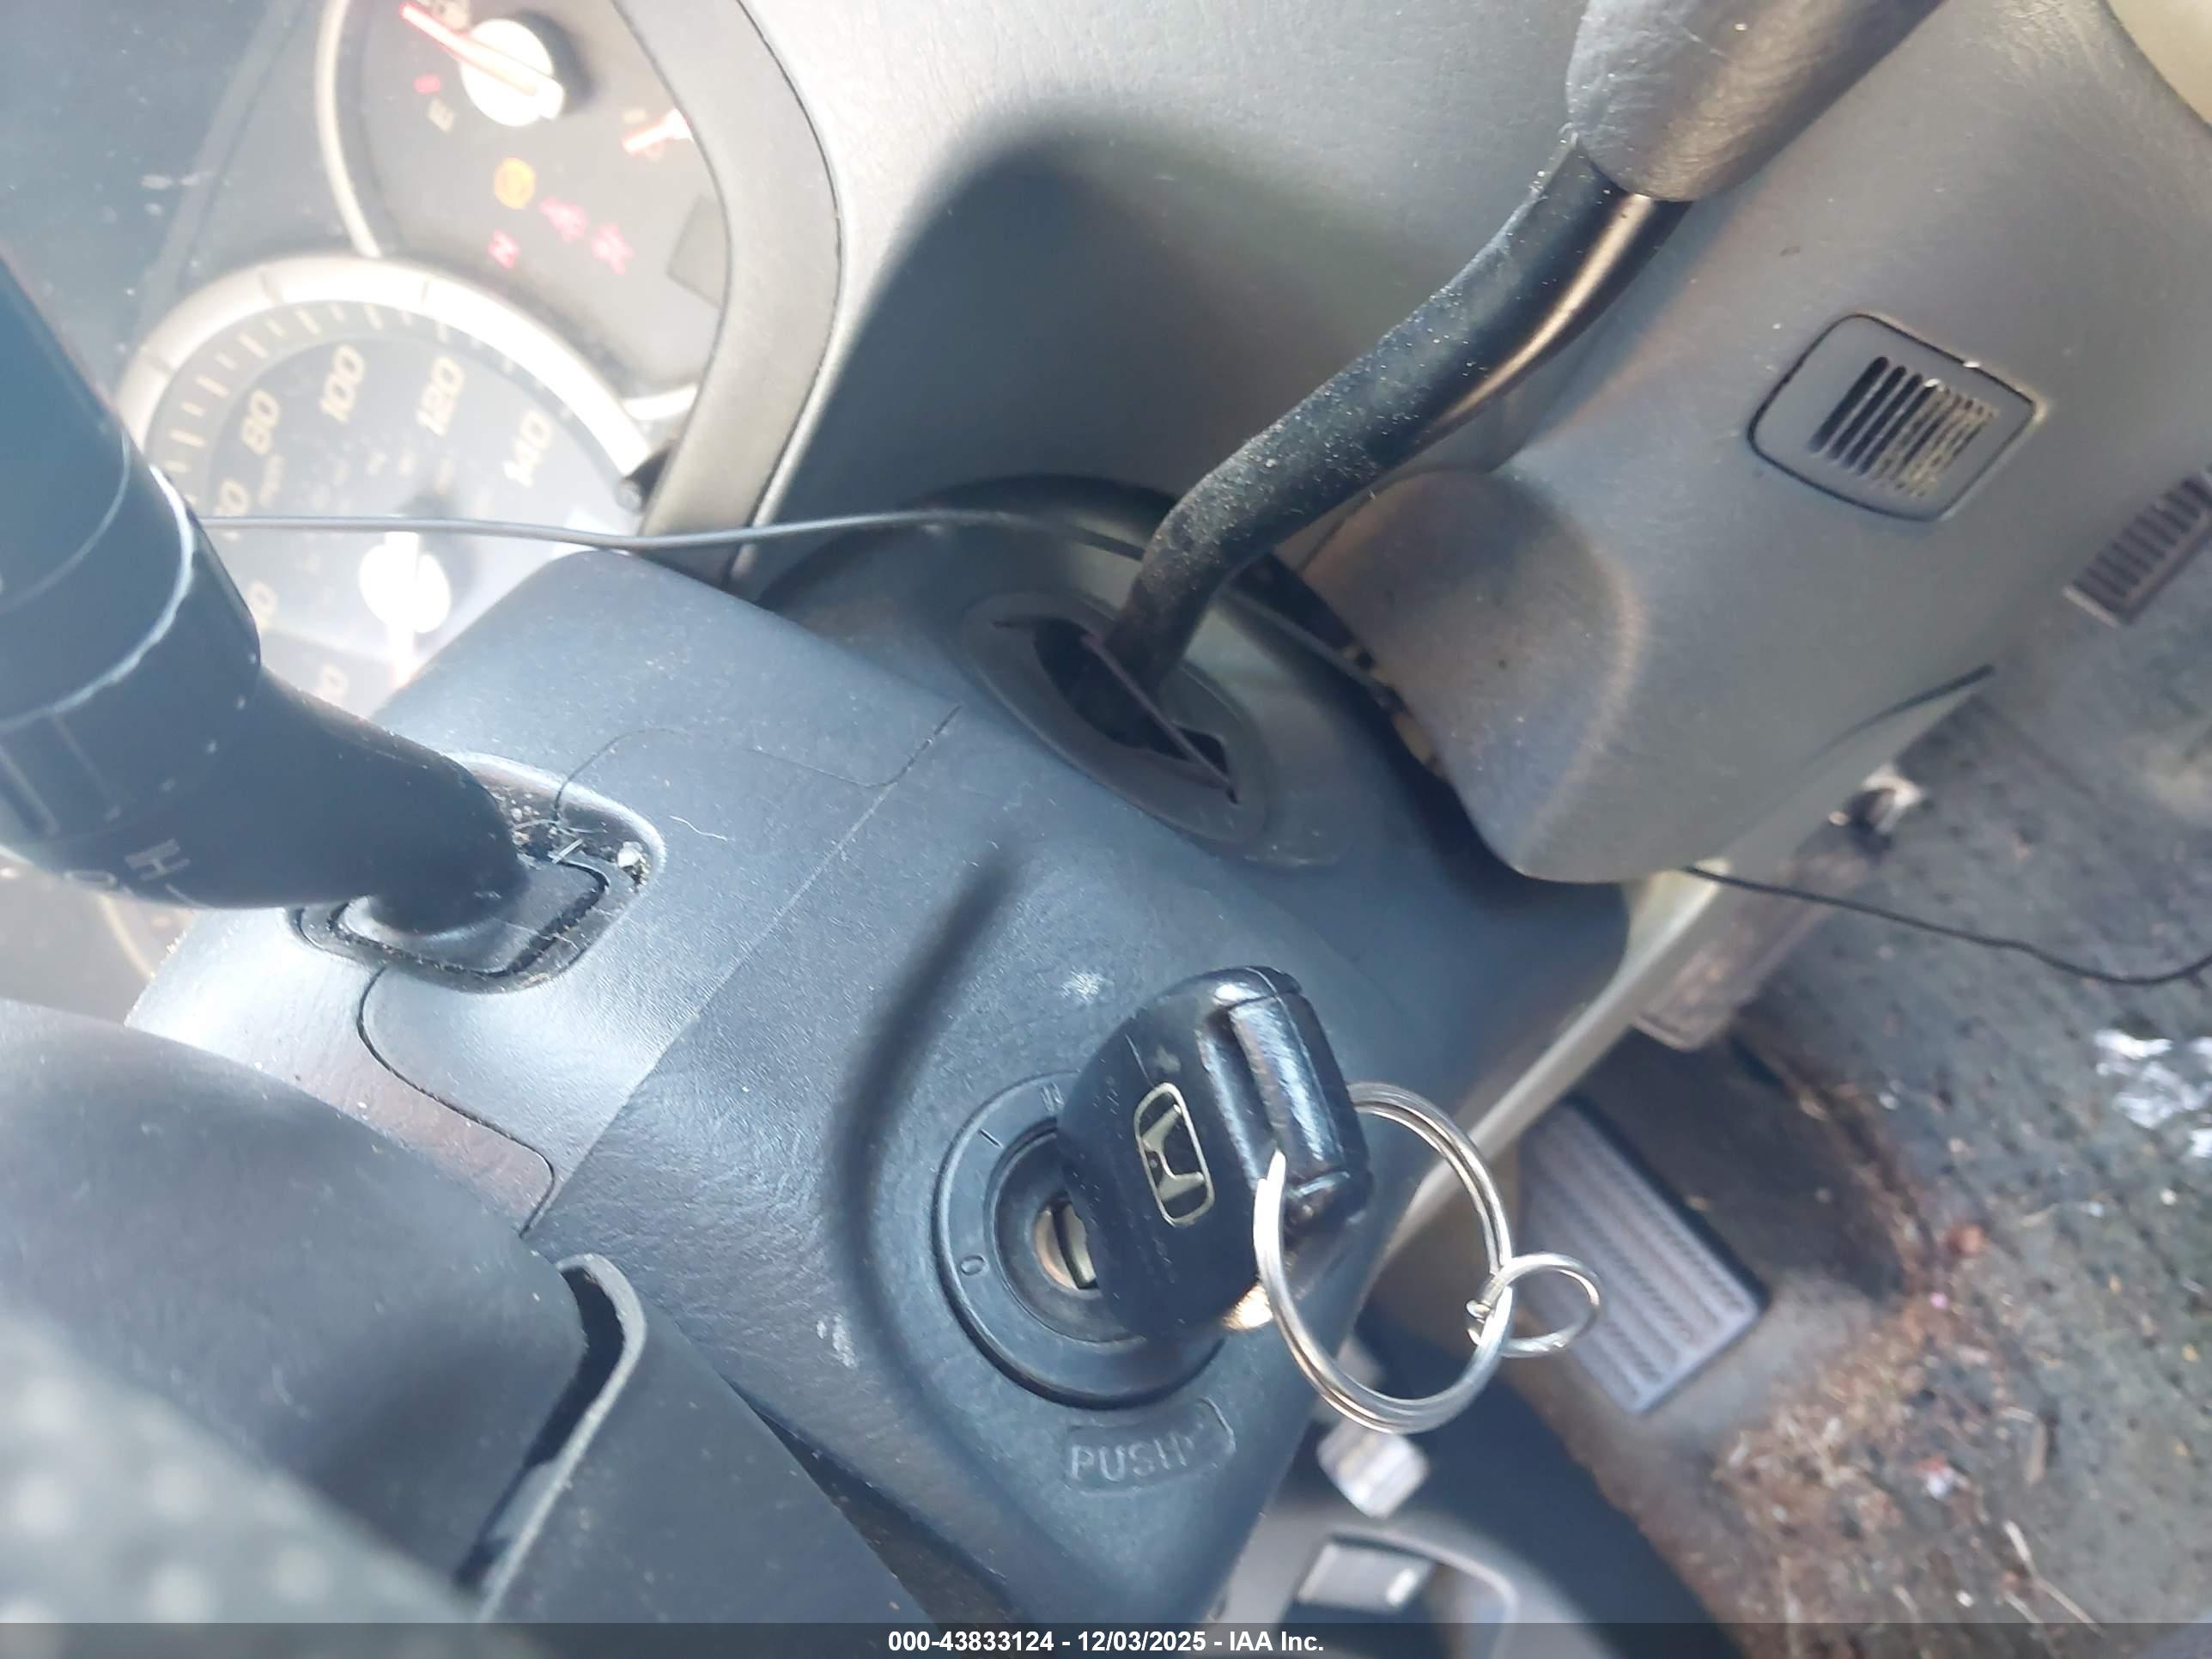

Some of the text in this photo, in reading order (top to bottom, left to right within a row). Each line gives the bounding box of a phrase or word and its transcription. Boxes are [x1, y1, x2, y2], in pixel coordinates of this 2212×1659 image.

[241, 390, 279, 454] 80
[320, 344, 364, 423] 100
[416, 357, 465, 437] 120
[503, 411, 552, 489] 140
[1070, 1432, 1194, 1483] PUSH
